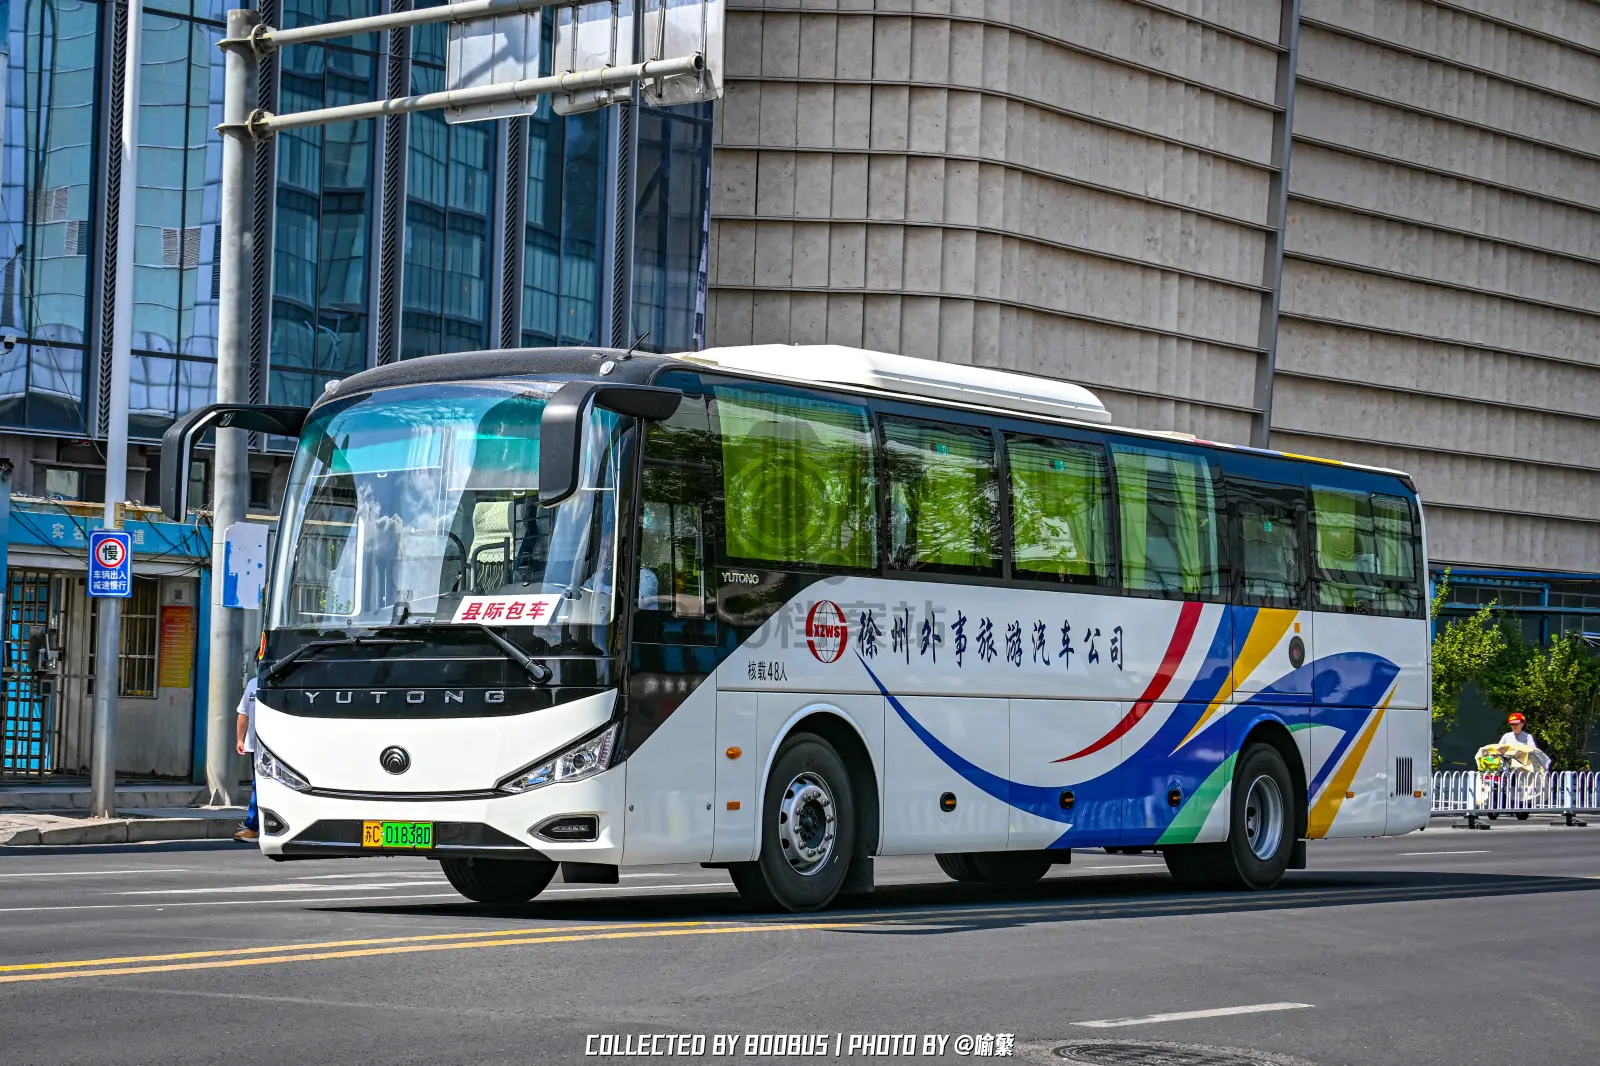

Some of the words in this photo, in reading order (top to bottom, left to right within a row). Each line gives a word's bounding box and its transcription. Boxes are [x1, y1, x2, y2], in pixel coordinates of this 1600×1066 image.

[102, 545, 118, 561] 慢
[93, 570, 127, 580] 车辆出入
[721, 572, 760, 585] YUTONG
[93, 580, 127, 591] 减速慢行
[461, 600, 549, 621] 县际包车
[813, 623, 841, 639] XZWS
[858, 607, 1124, 673] 徐州外事旅游汽车公司
[747, 660, 788, 682] 核载48人
[304, 690, 506, 705] YUTONG
